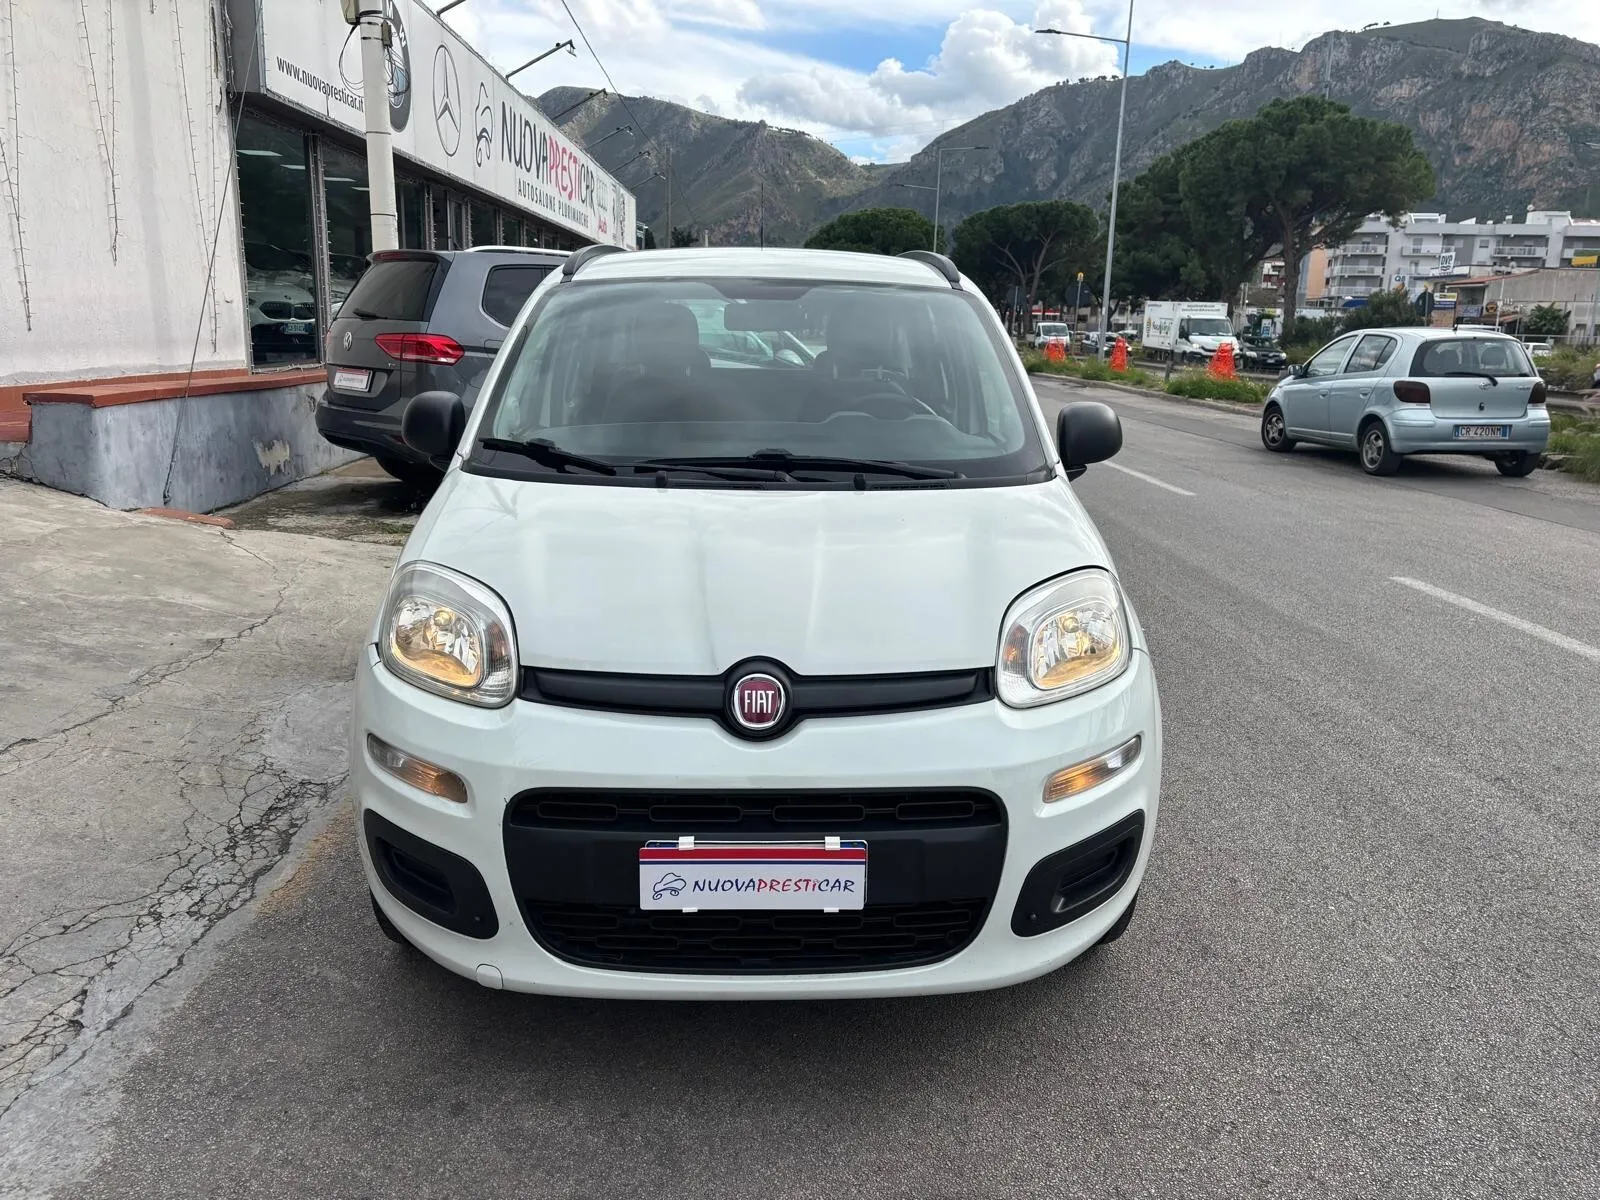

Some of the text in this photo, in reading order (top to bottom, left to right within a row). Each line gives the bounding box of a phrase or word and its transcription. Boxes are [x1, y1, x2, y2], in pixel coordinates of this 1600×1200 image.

[276, 56, 364, 112] www.nuovapresticar.it
[518, 178, 556, 213] AUTOSALONE
[1460, 426, 1501, 436] CR 420NM
[744, 690, 775, 714] FIAT
